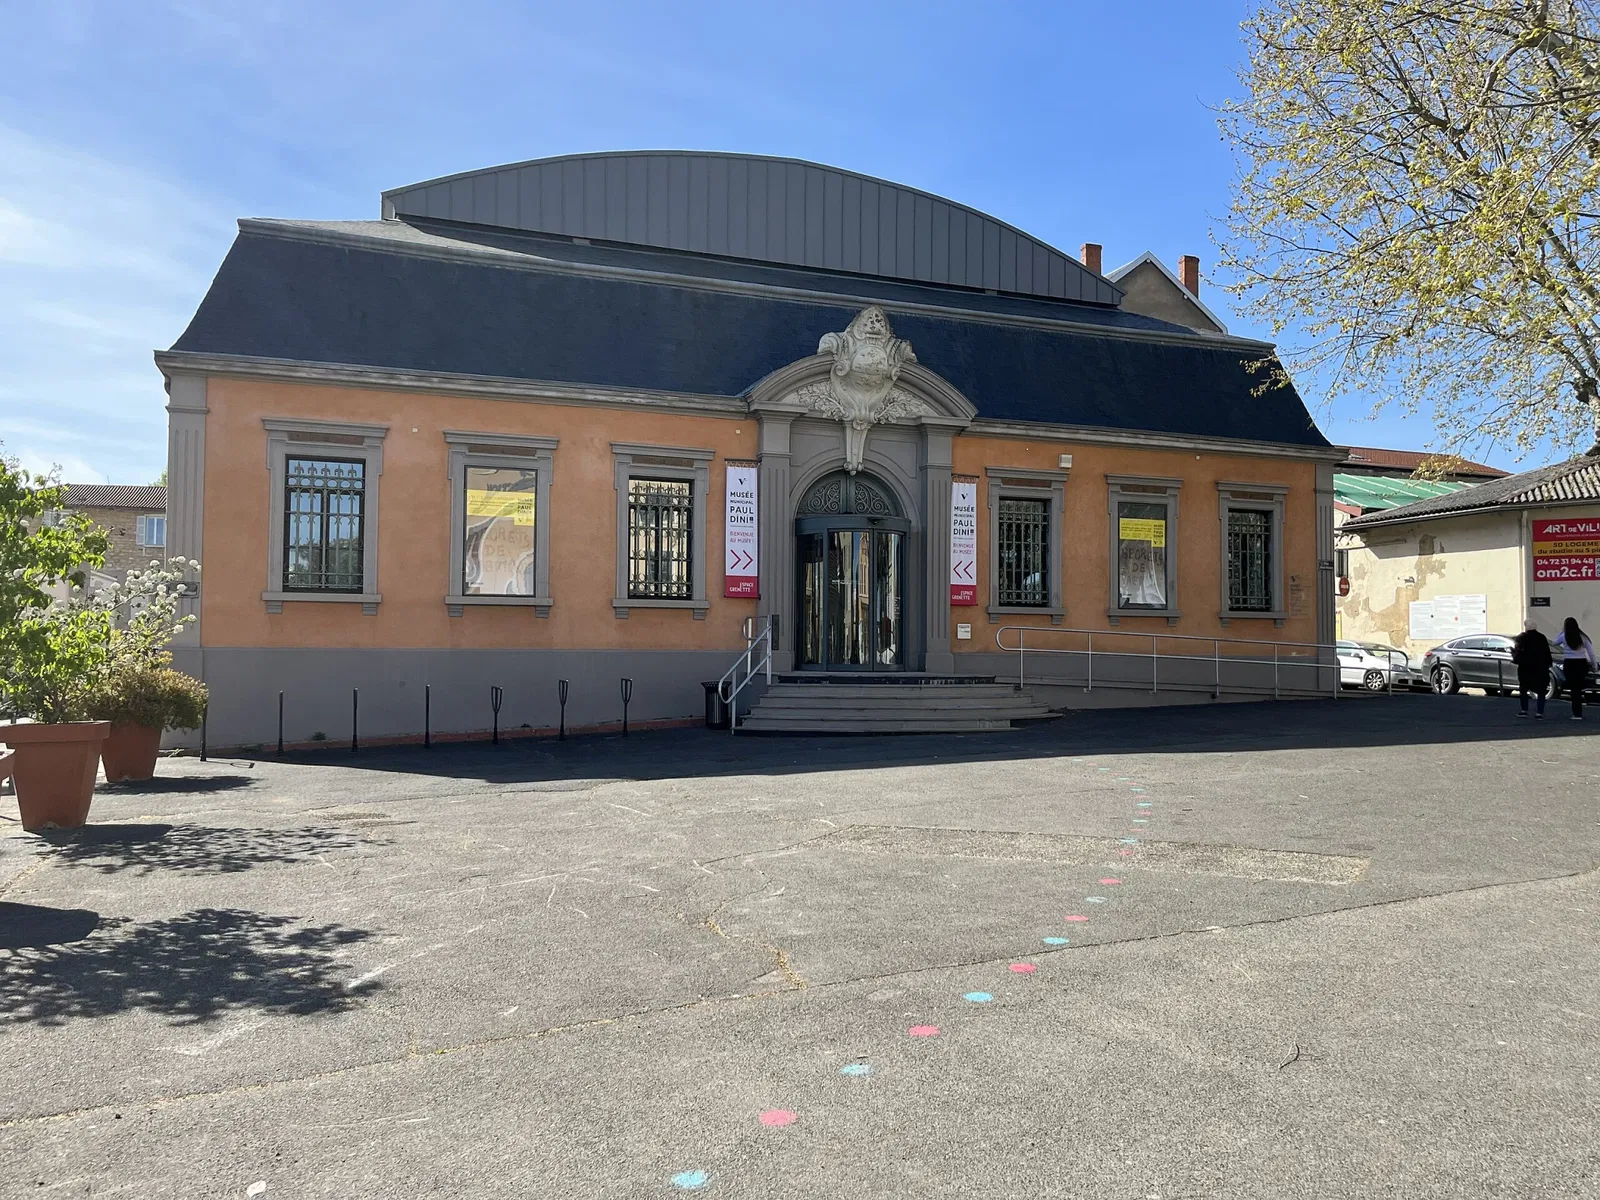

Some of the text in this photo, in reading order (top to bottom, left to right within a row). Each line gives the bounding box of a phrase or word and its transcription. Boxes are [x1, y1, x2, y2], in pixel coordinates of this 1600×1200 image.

[730, 506, 754, 514] PAUL
[730, 515, 749, 523] DINI
[1542, 524, 1567, 533] ART
[1132, 563, 1145, 573] DE
[1537, 566, 1594, 578] om2c.fr
